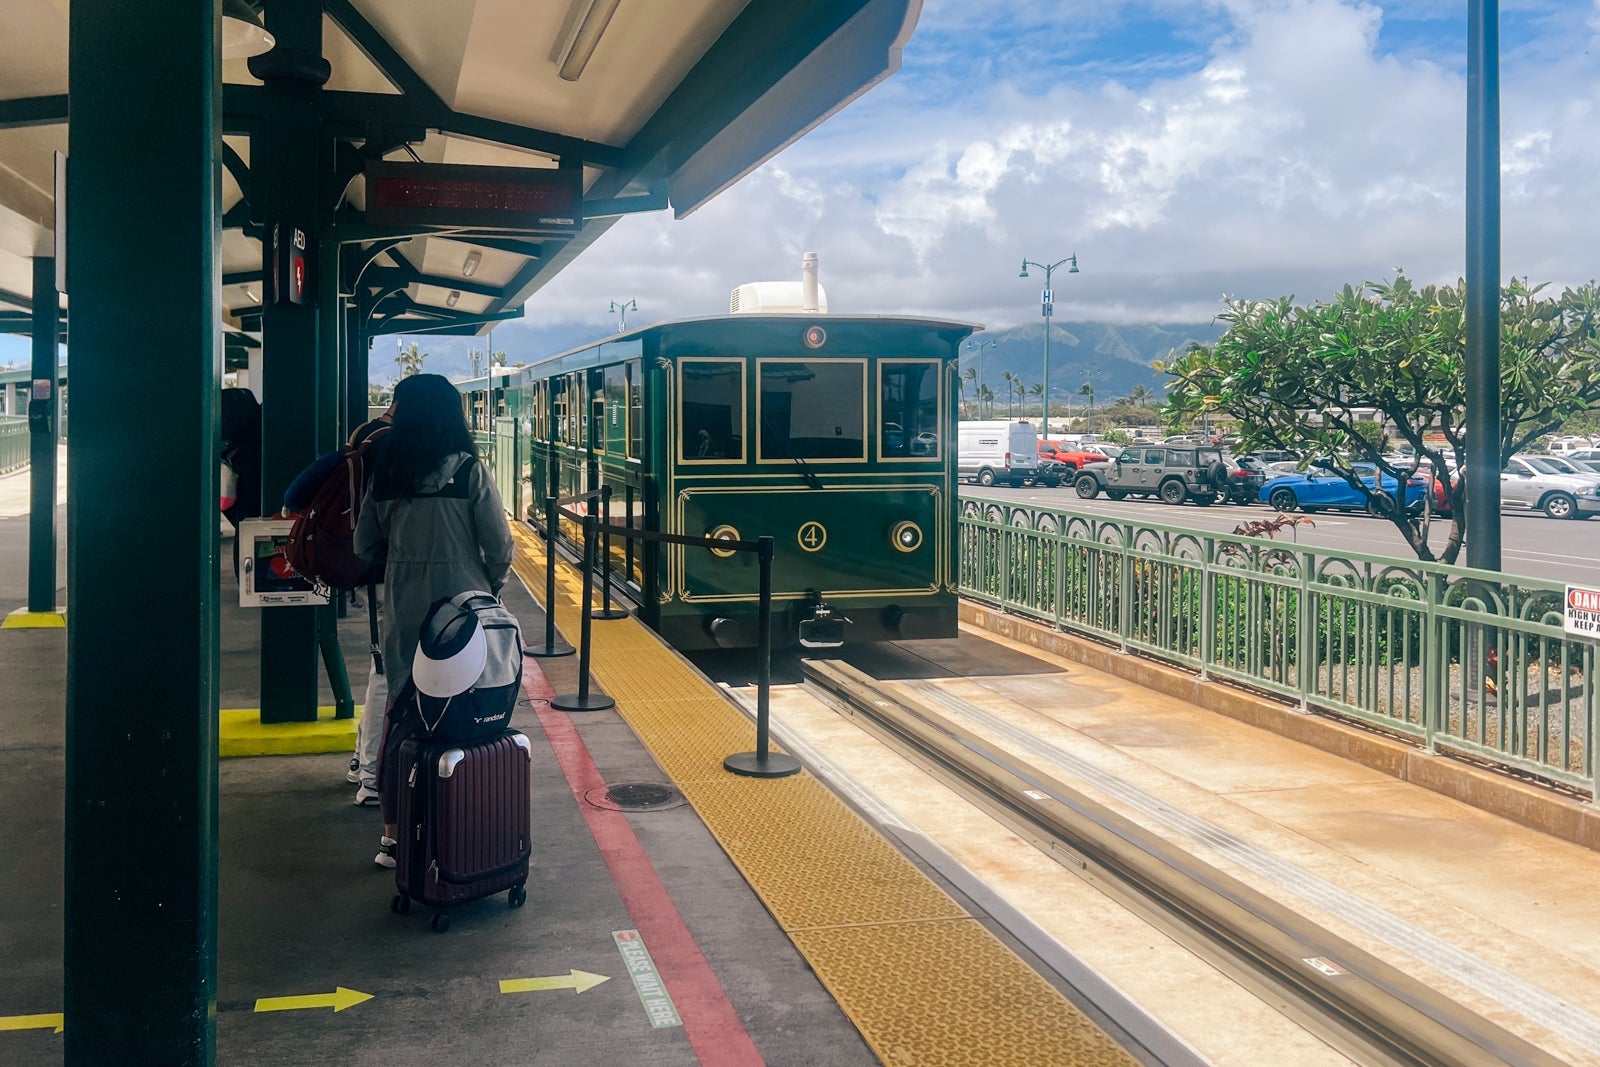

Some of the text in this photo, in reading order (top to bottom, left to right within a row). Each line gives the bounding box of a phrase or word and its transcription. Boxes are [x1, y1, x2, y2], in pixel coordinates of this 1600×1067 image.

[294, 227, 306, 250] AED
[1043, 290, 1051, 303] H
[804, 526, 818, 546] 4
[1574, 591, 1600, 610] DAN
[1568, 609, 1589, 621] HIGH
[1574, 620, 1594, 631] KEEP
[620, 940, 652, 972] PLEASE
[635, 972, 664, 996] WAIT
[645, 998, 678, 1026] HERE
